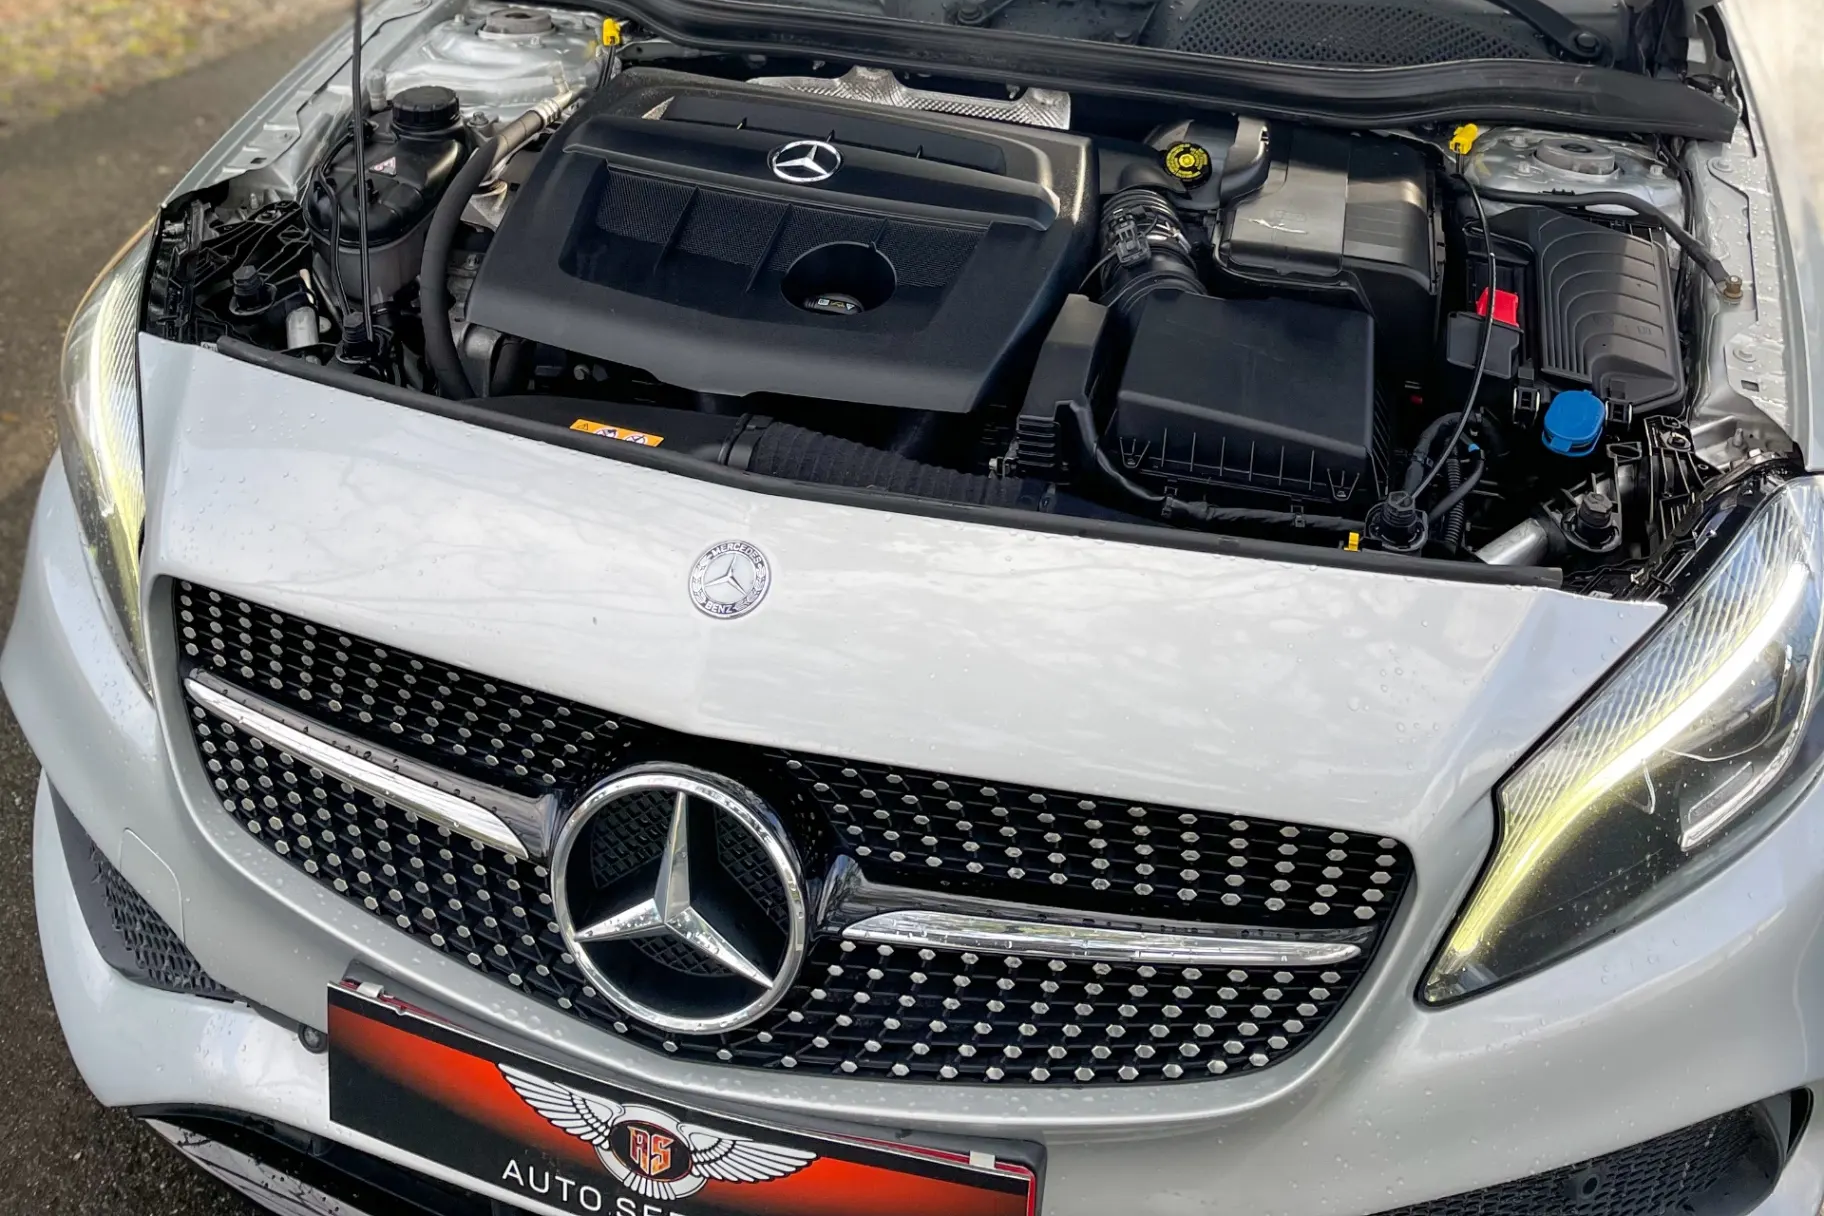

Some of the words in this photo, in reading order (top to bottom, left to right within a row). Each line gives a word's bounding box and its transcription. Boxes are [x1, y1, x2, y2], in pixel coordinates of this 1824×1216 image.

[711, 542, 762, 564] MERCEDES
[704, 601, 734, 614] BENZ
[501, 1159, 602, 1212] AUTO
